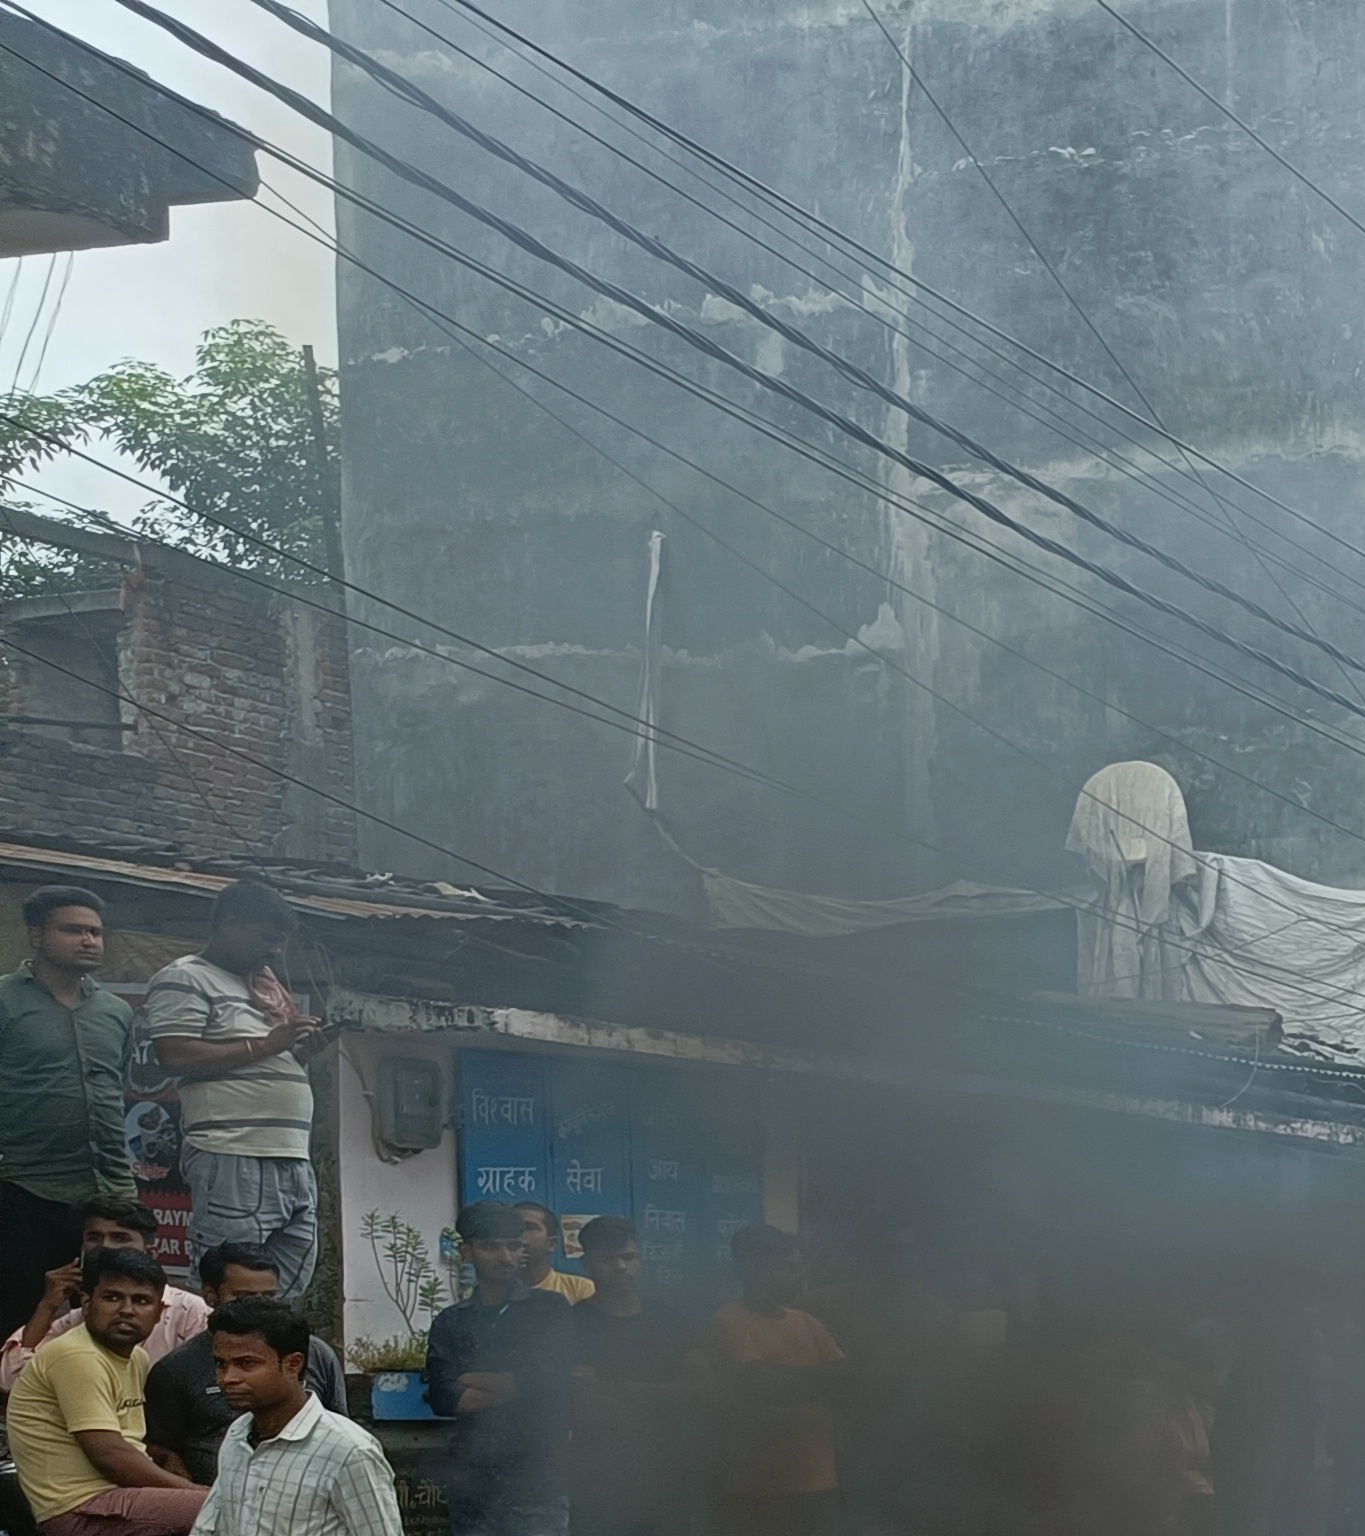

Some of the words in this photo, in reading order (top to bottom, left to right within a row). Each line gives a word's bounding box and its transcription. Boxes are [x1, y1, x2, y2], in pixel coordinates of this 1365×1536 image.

[471, 1087, 535, 1125] विश्वास
[477, 1166, 537, 1196] ग्राहक
[567, 1159, 604, 1194] सेवा
